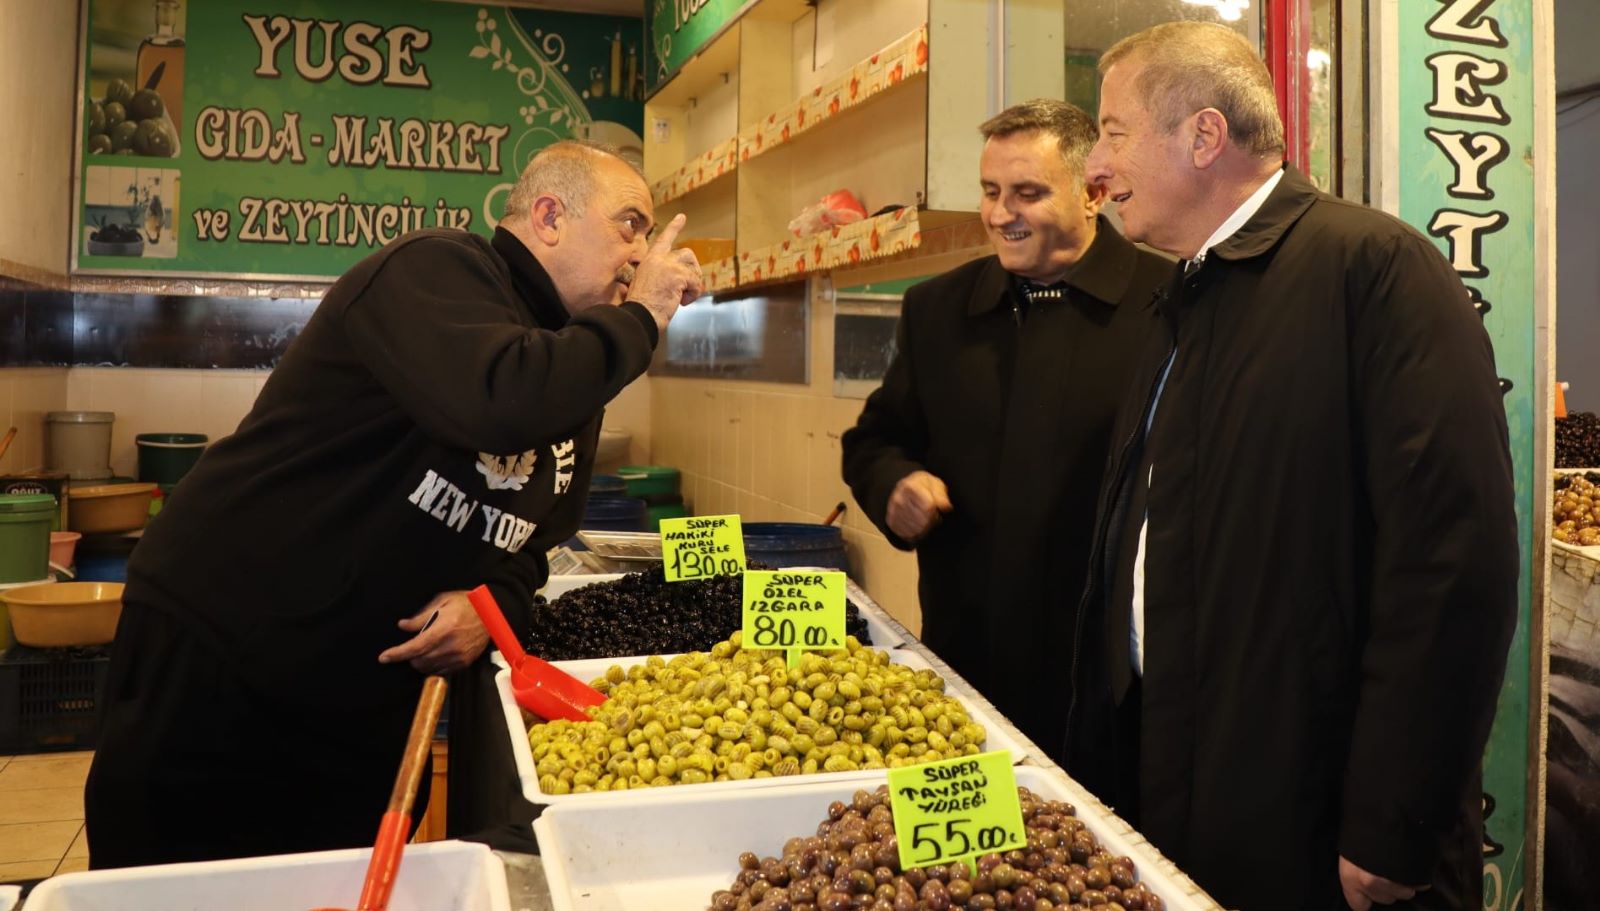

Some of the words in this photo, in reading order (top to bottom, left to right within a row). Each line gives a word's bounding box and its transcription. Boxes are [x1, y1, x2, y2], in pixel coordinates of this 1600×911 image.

[242, 13, 432, 89] YUSE
[195, 106, 306, 164] GIDA
[328, 114, 509, 173] MARKET
[193, 208, 230, 241] ve
[407, 469, 478, 533] NEW
[679, 540, 714, 550] KURU
[700, 545, 730, 554] SELE
[923, 760, 983, 783] SÜPER
